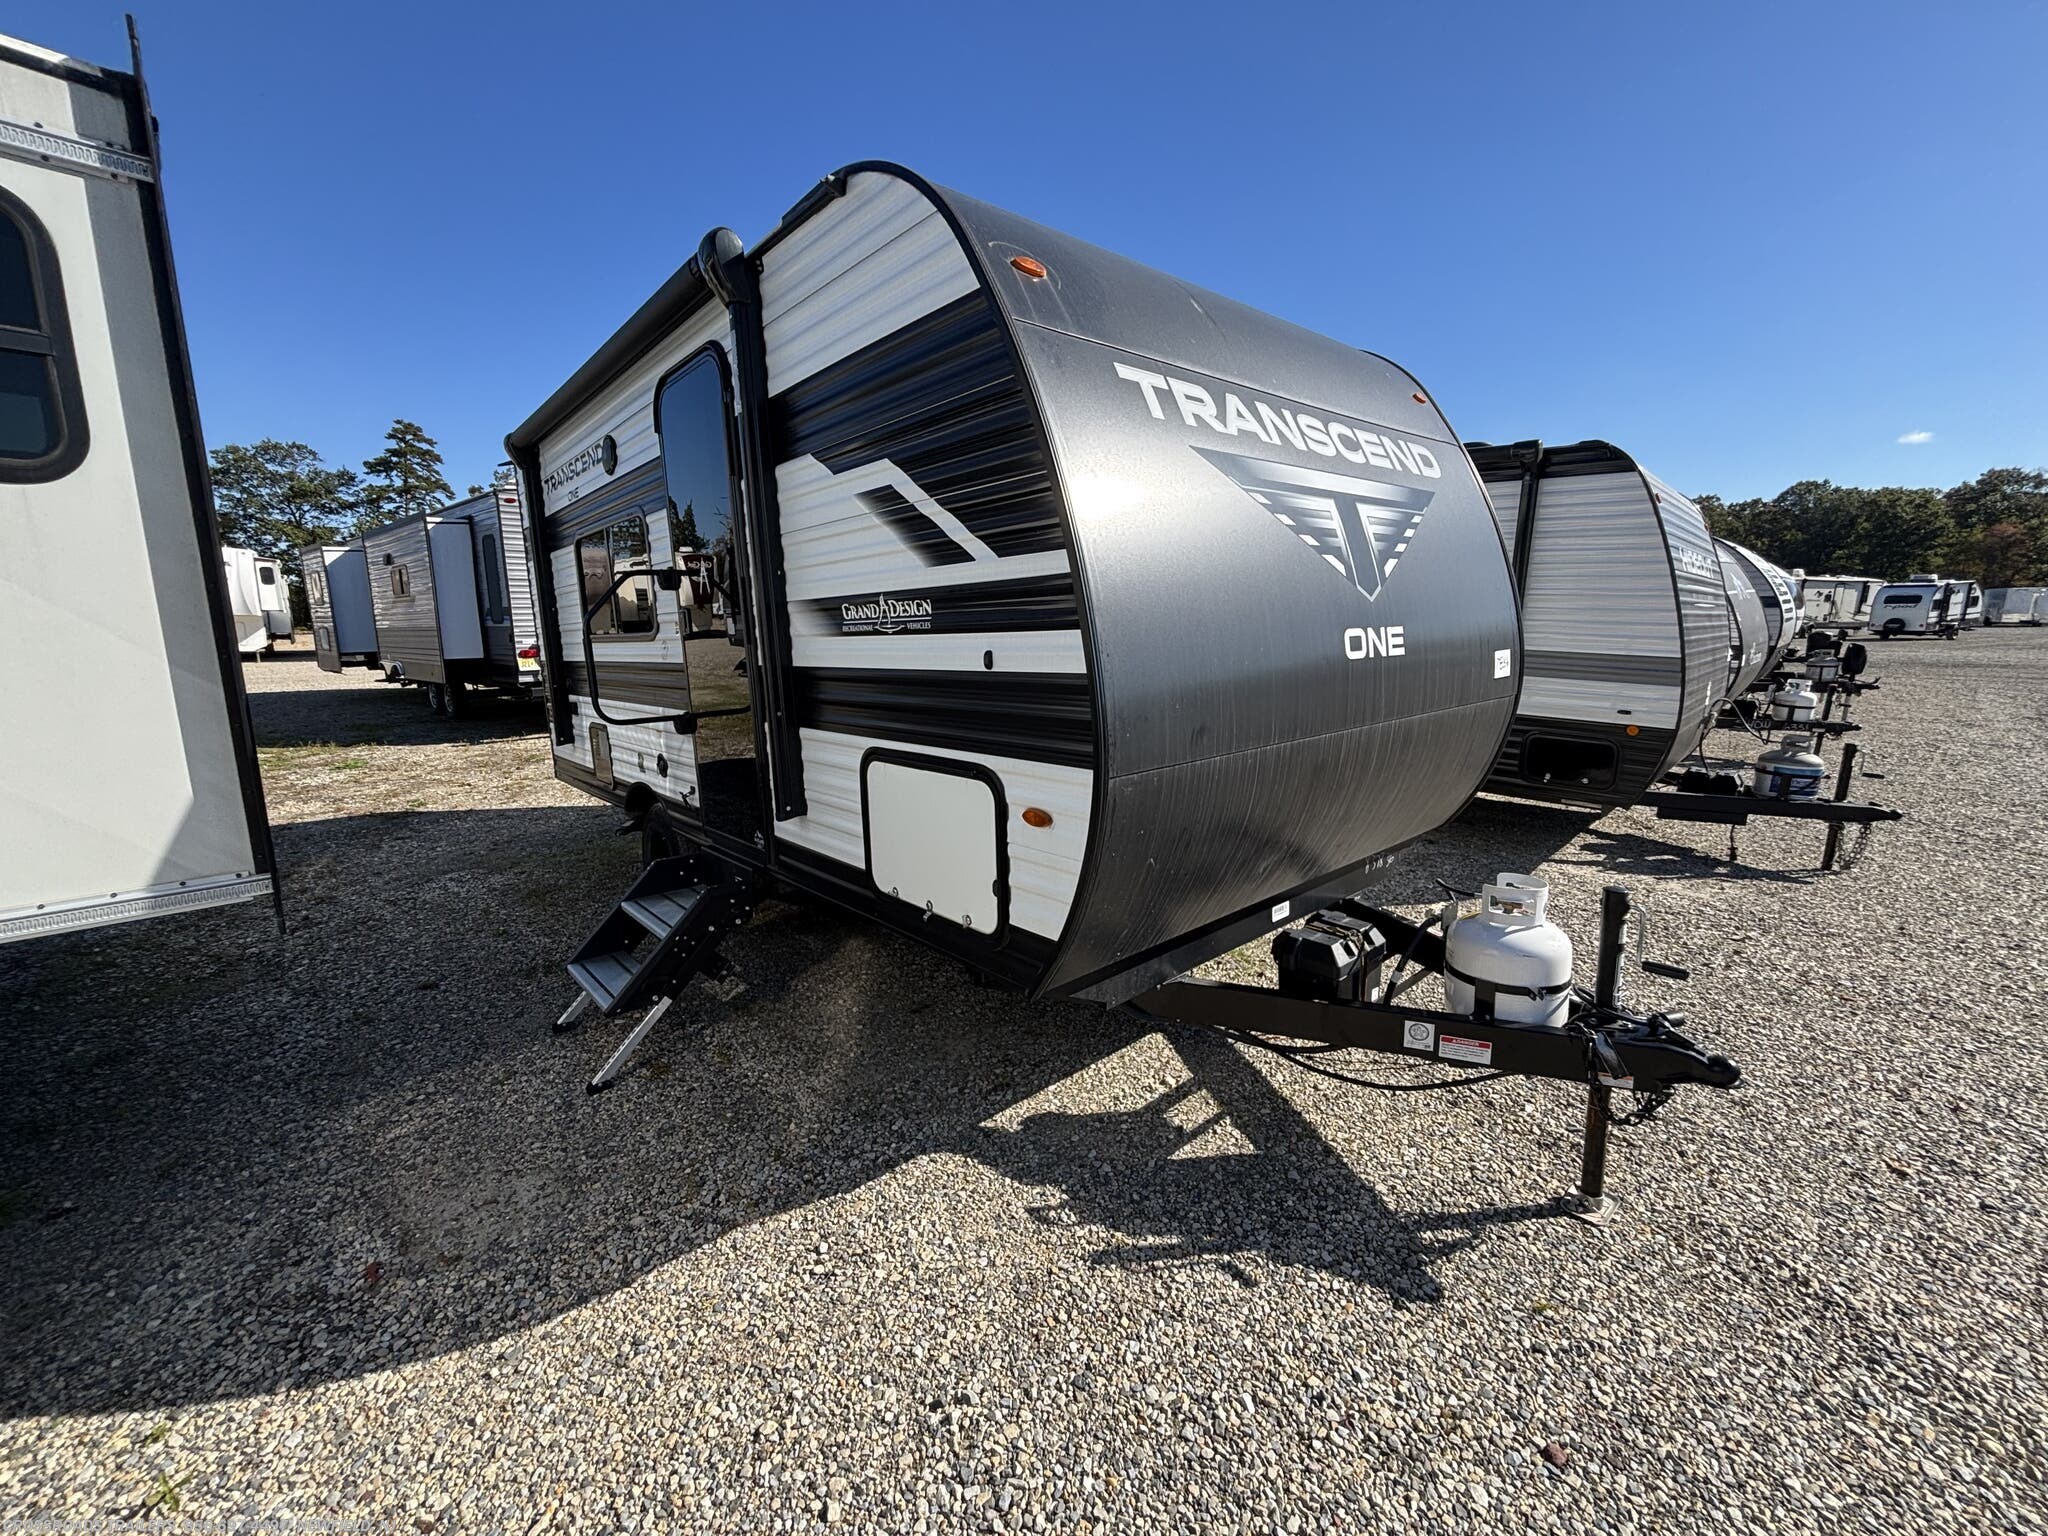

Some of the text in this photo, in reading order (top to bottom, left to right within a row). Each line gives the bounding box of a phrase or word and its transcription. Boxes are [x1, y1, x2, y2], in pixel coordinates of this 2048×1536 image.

[1113, 361, 1442, 479] TRANSCEND
[544, 443, 603, 496] TRANSCEND
[841, 599, 932, 620] GRAND DESIGN
[1343, 625, 1406, 660] ONE
